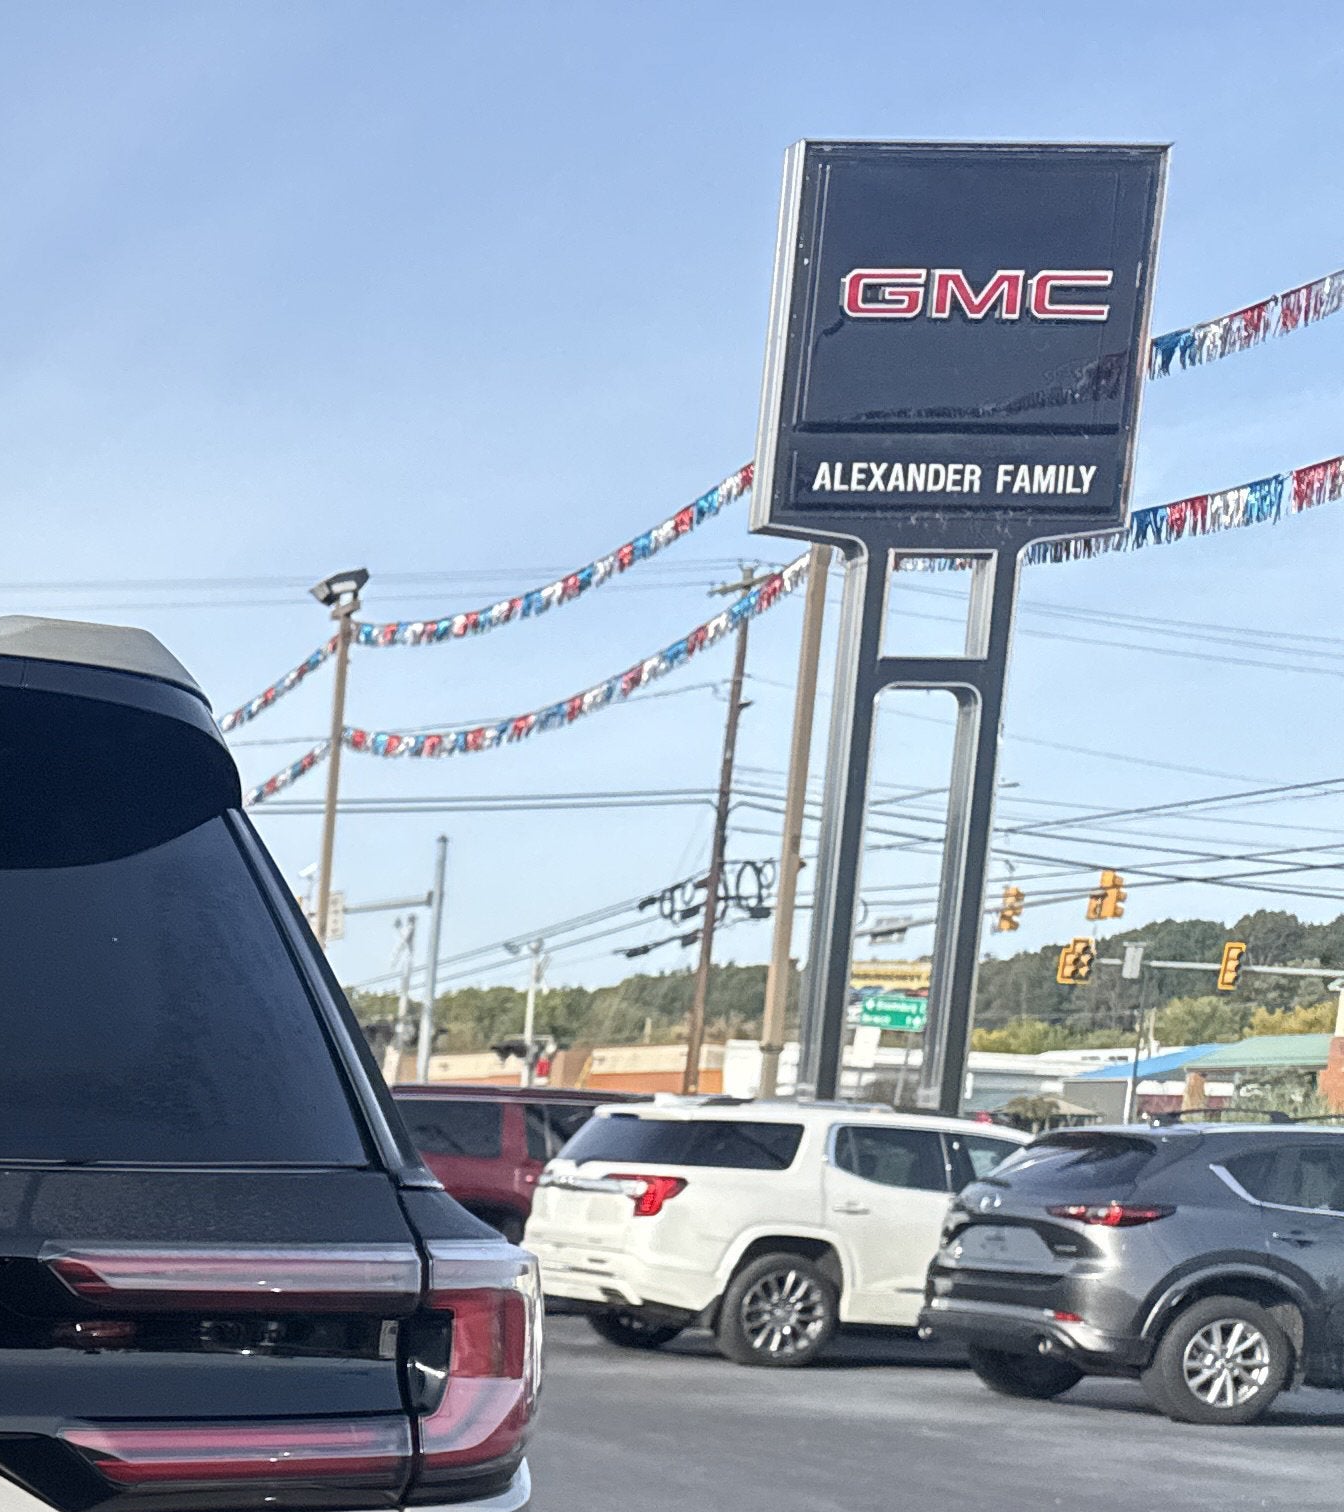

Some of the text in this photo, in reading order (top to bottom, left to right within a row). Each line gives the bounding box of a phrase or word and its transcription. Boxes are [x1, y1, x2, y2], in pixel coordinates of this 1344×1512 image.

[841, 268, 1113, 320] GMC
[812, 462, 1097, 494] ALEXANDER FAMILY
